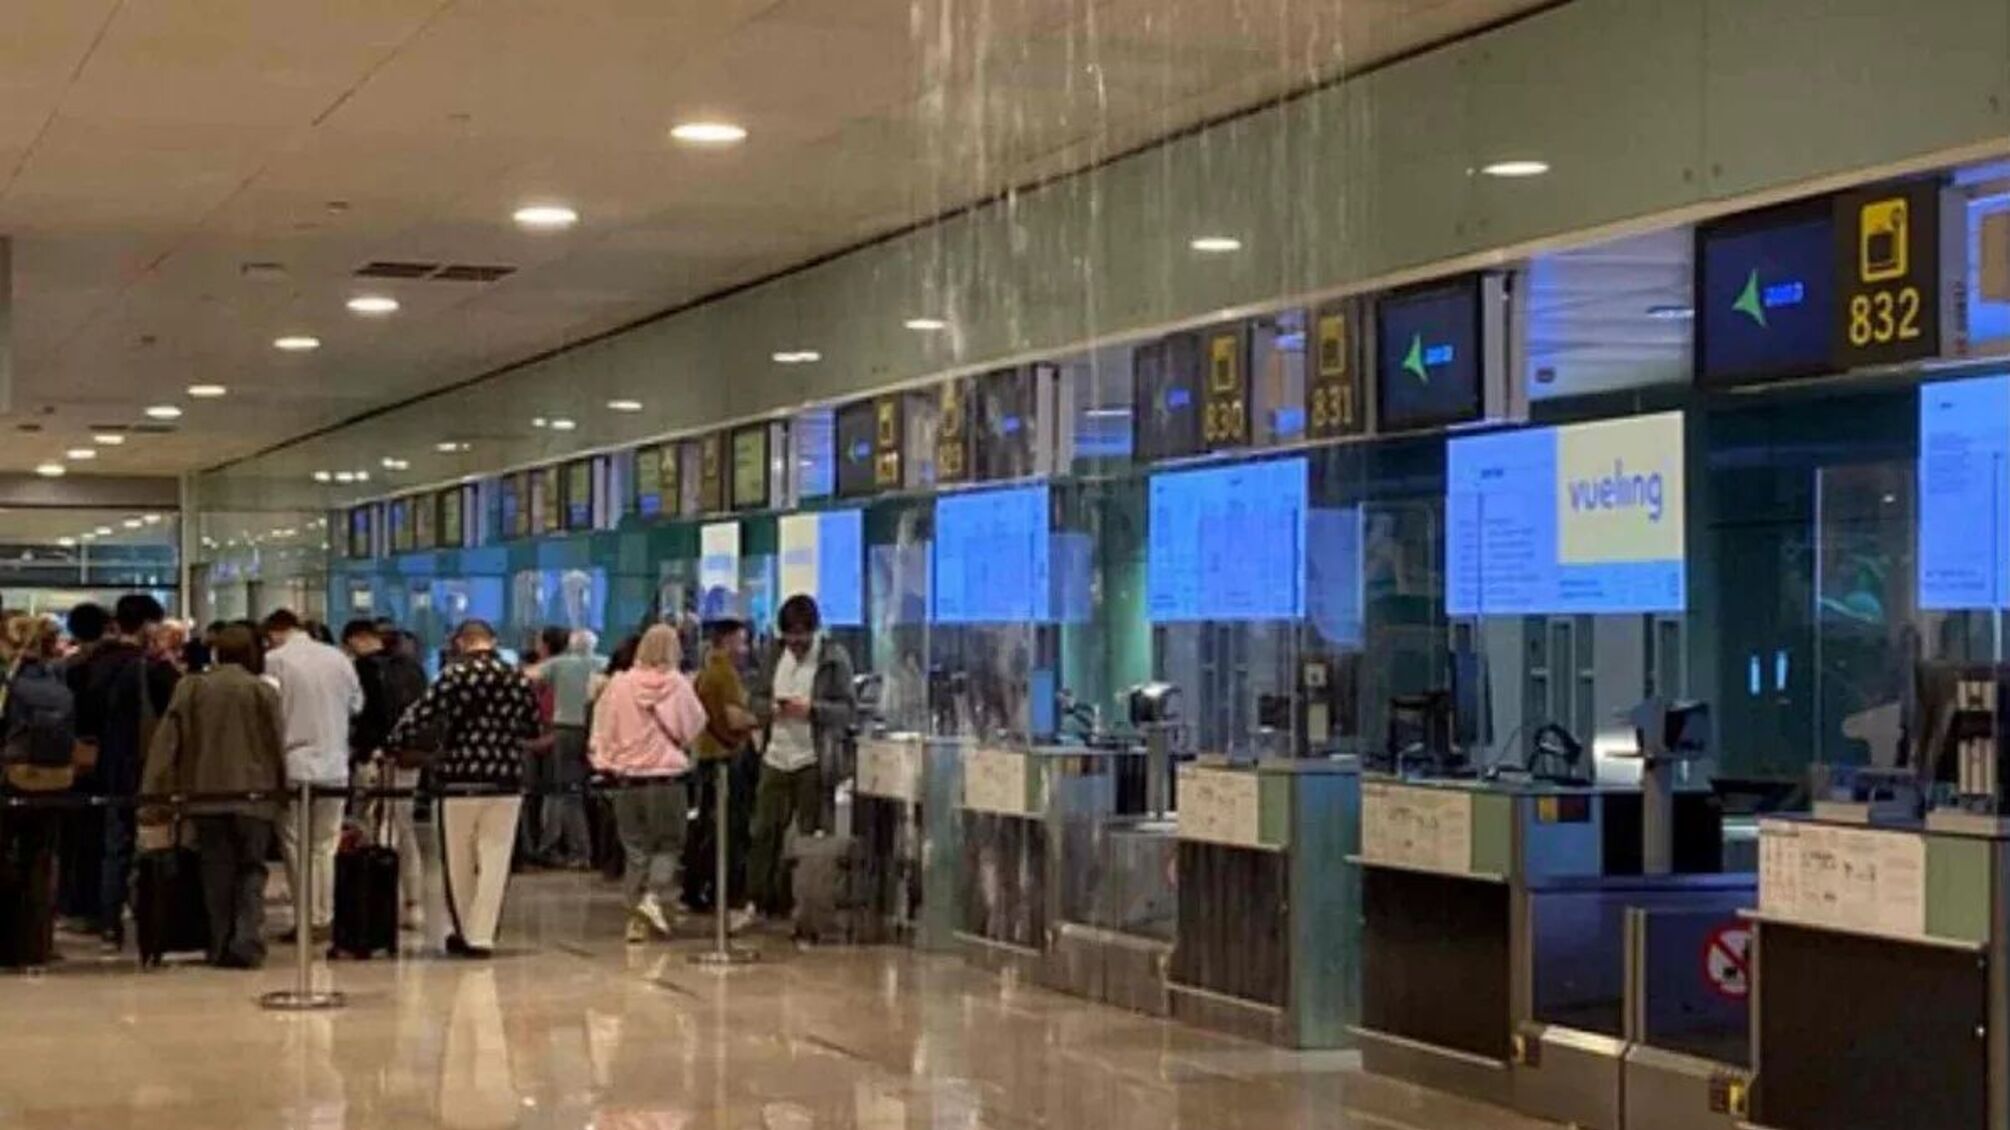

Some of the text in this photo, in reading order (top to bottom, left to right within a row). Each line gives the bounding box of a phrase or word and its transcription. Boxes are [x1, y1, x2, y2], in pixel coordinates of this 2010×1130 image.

[1849, 287, 1919, 344] 832
[1206, 399, 1244, 441] 830
[1312, 384, 1352, 427] 831
[1568, 456, 1662, 523] vueling
